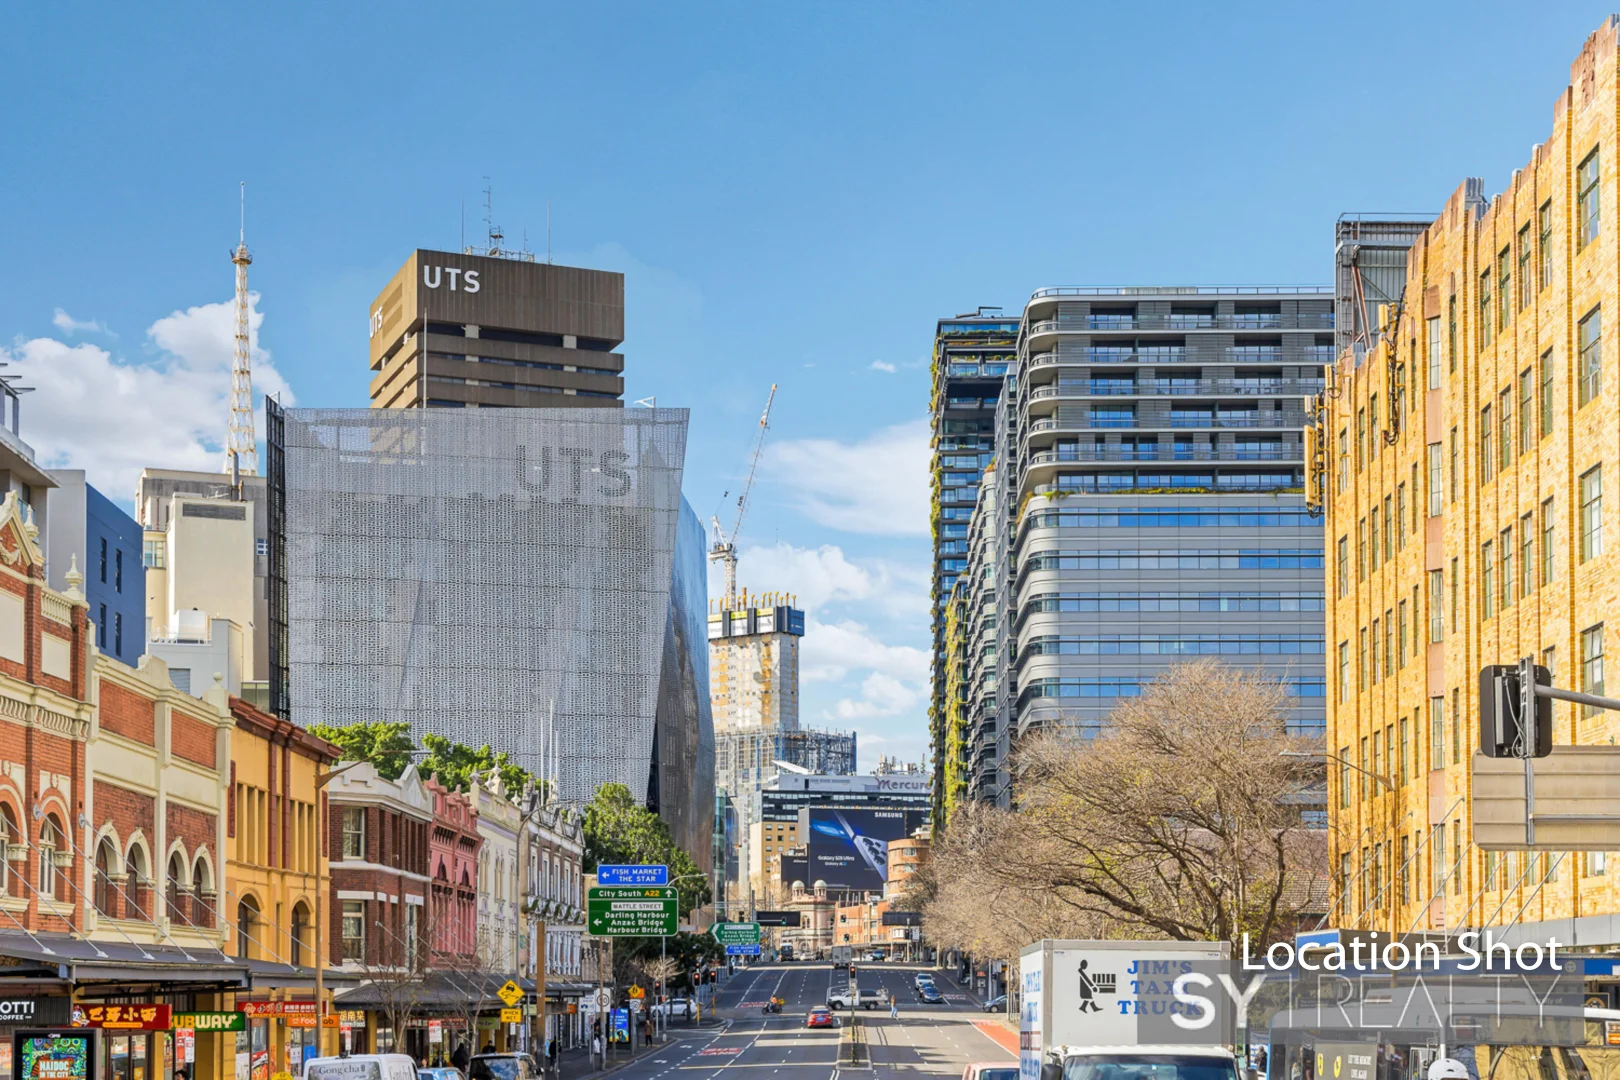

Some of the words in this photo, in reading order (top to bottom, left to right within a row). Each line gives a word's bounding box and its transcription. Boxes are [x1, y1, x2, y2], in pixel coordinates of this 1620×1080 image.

[423, 264, 481, 293] UTS
[370, 306, 383, 338] UTS
[516, 444, 631, 498] UTS
[874, 776, 933, 791] Mercure
[599, 890, 615, 898] City
[638, 920, 664, 928] Bridge
[641, 927, 667, 935] Bridge
[1127, 960, 1193, 975] JIM'S
[0, 1001, 35, 1014] OTTI
[1117, 1000, 1202, 1015] TRUCK
[171, 1014, 238, 1029] UBWAY
[318, 1066, 342, 1076] Gong
[344, 1064, 359, 1073] cha
